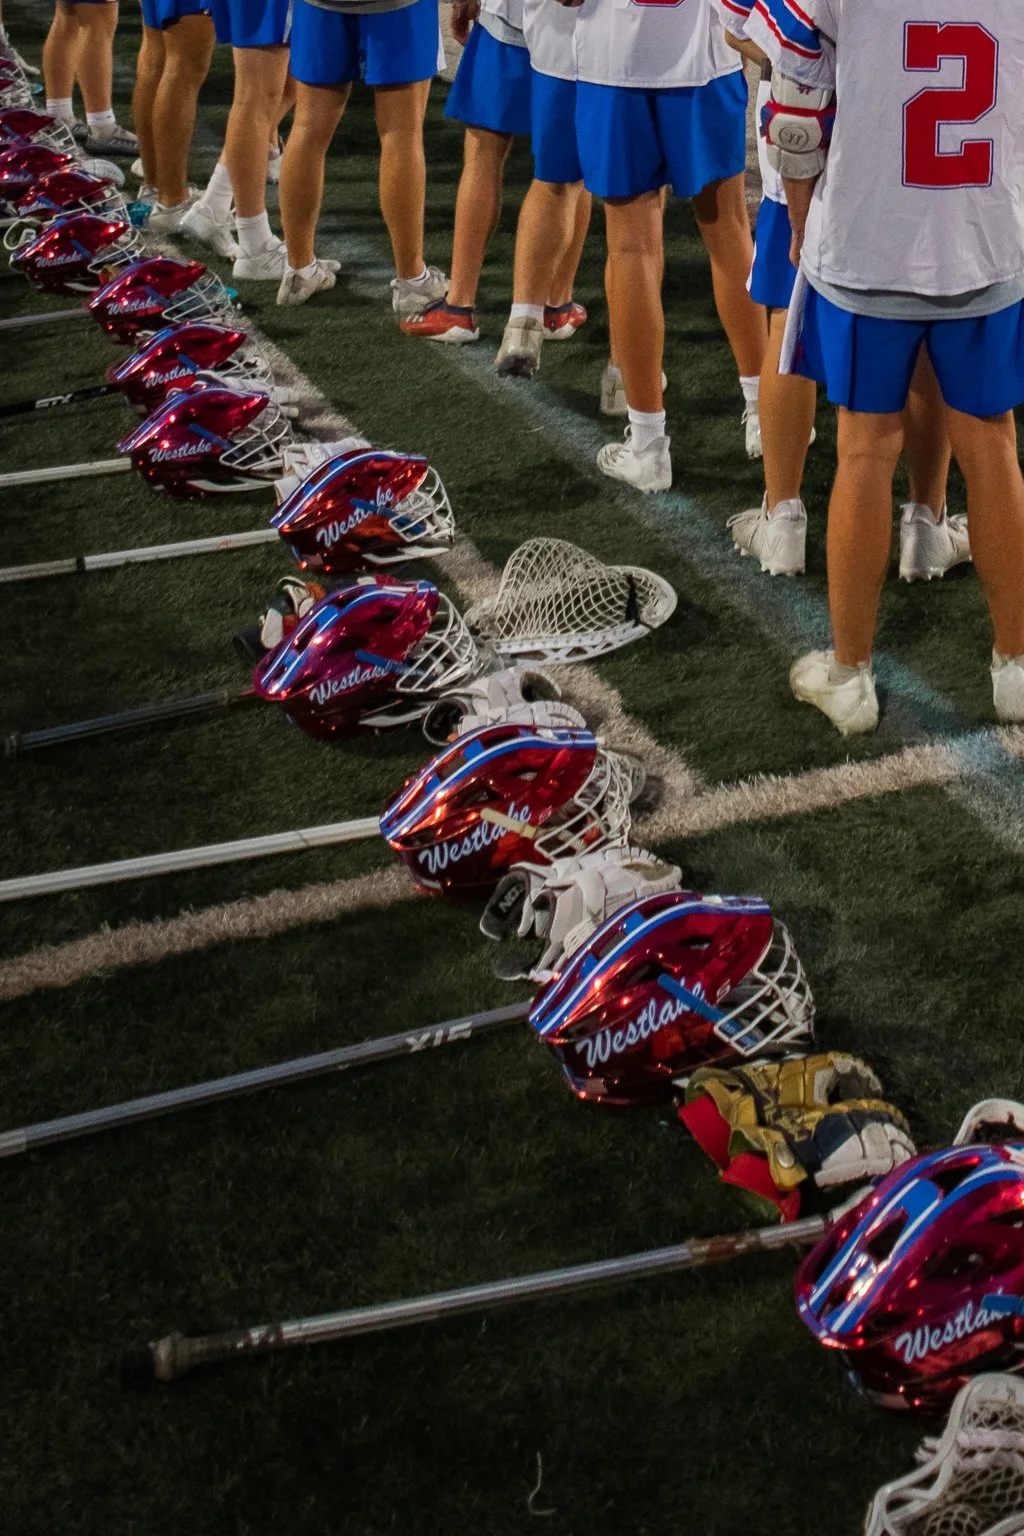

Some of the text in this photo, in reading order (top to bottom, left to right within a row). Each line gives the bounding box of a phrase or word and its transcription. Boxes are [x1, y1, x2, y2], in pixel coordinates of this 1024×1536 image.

[902, 21, 999, 190] 2
[35, 251, 86, 268] Westlake
[107, 297, 159, 315] Westlake
[34, 394, 73, 409] STX
[148, 438, 213, 463] Westlake
